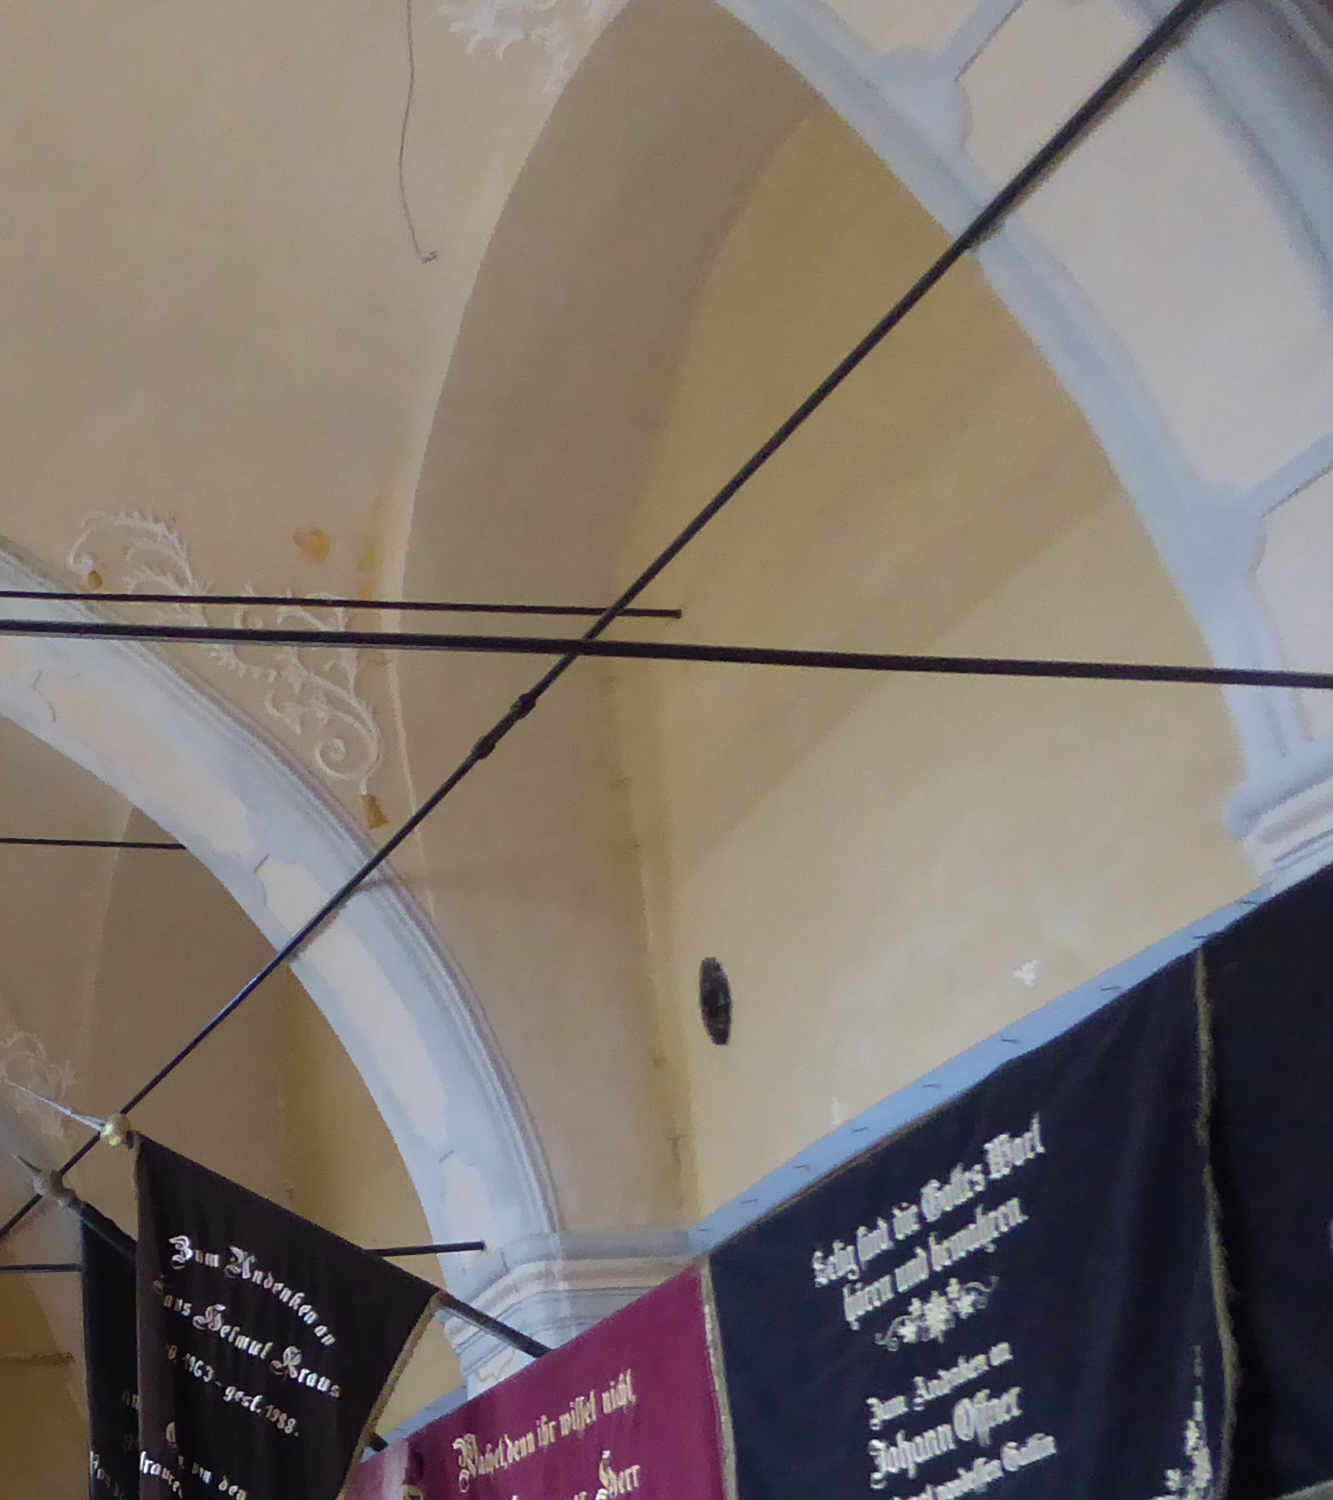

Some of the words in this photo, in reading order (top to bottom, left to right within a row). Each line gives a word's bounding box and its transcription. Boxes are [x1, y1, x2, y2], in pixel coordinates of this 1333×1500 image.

[168, 1234, 220, 1270] Zum
[223, 1244, 319, 1325] Andenken
[313, 1324, 336, 1347] an
[192, 1303, 274, 1360] Helmut
[269, 1345, 340, 1398] Kraus
